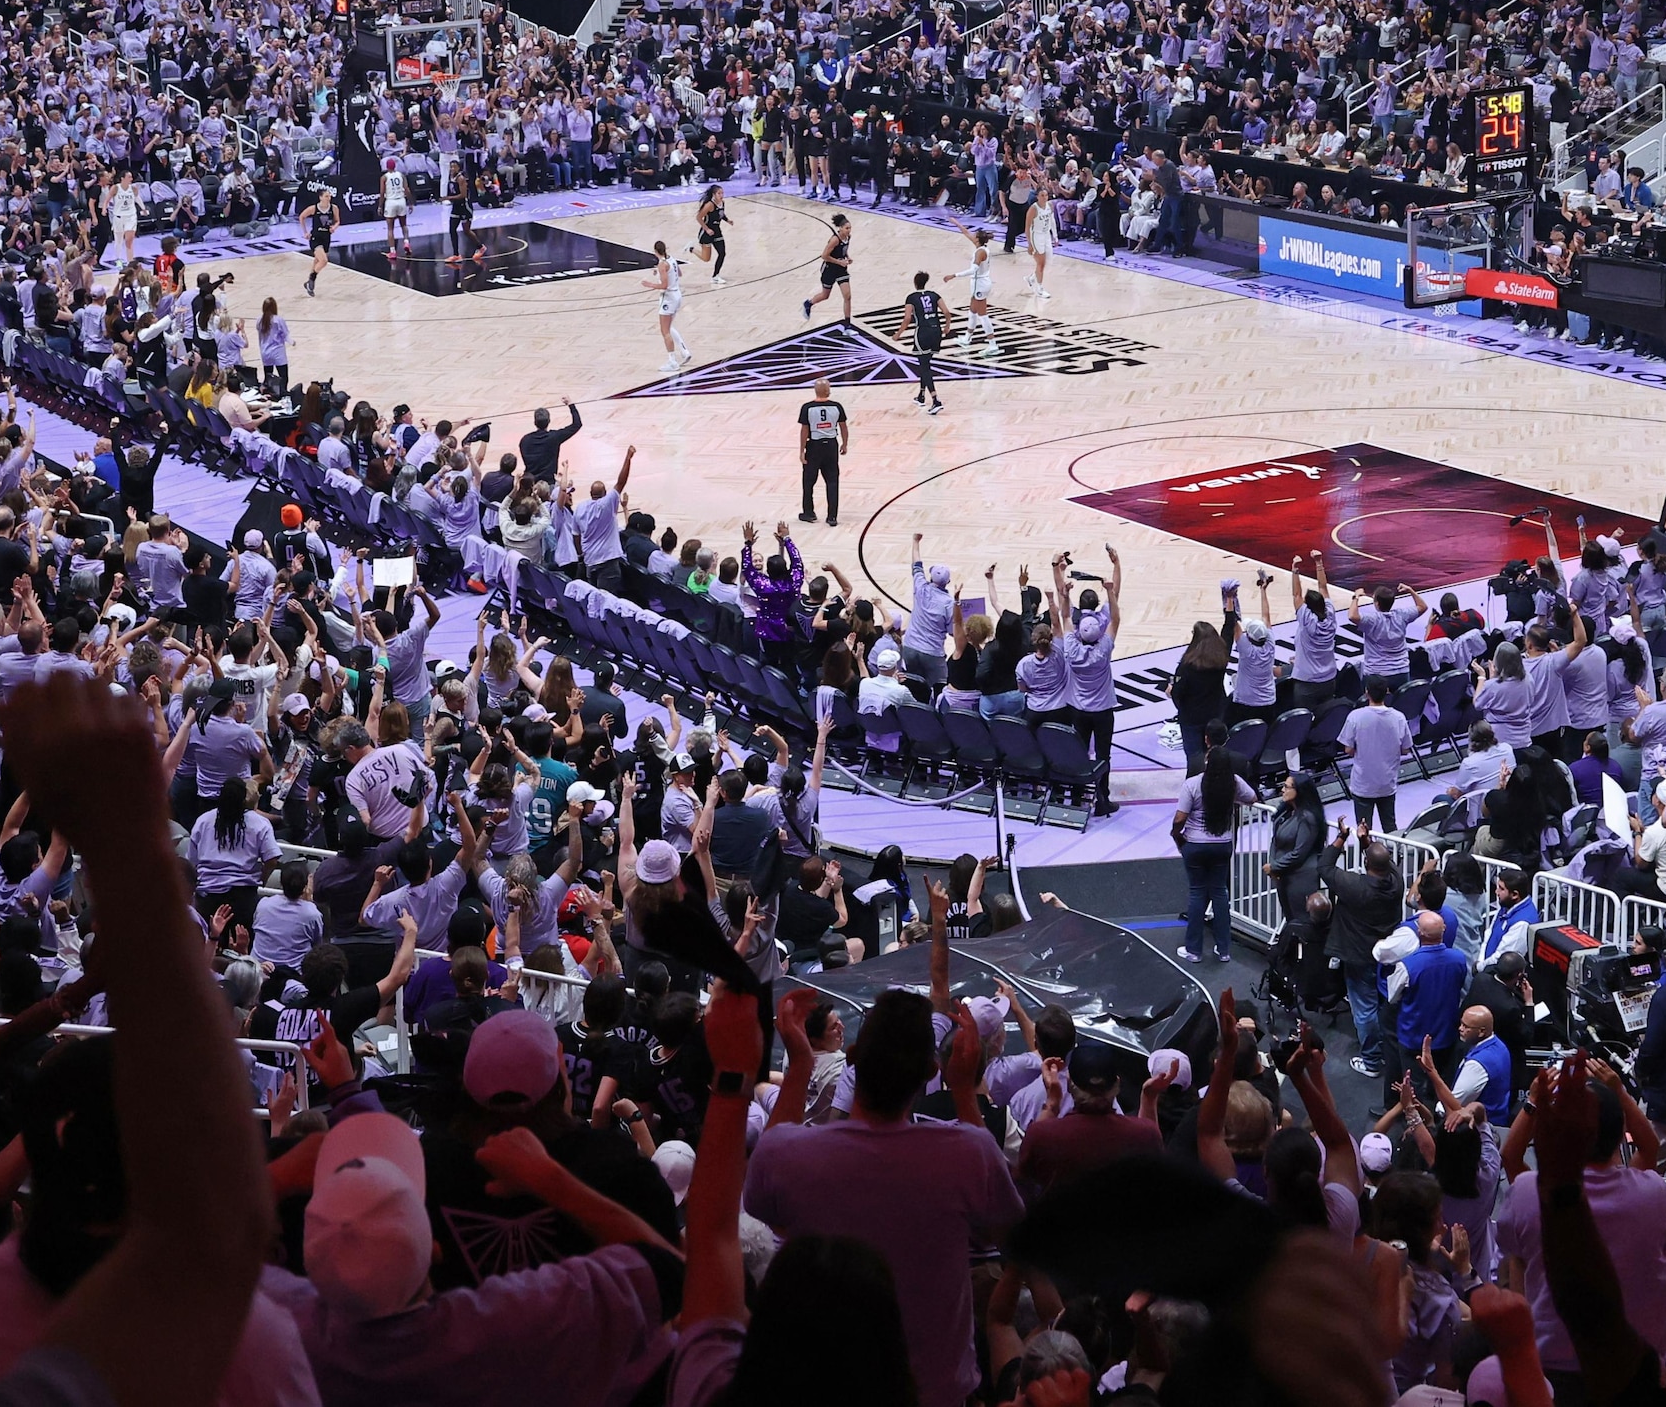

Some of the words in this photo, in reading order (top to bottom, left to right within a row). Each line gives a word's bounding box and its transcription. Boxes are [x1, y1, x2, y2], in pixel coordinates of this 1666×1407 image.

[1488, 94, 1523, 117] 5:48
[1481, 115, 1520, 154] 24
[1492, 157, 1528, 171] TISSOT
[390, 177, 401, 188] 10
[1279, 235, 1382, 280] JrWNBALeagues.com
[518, 266, 613, 283] WNBA
[1507, 281, 1555, 301] StateFarm
[920, 296, 932, 309] 12
[1054, 328, 1161, 354] STATE
[821, 409, 827, 422] 9
[1169, 467, 1293, 493] WNBA
[285, 544, 294, 561] 0
[360, 751, 400, 791] GSV
[634, 761, 646, 782] 5
[540, 777, 558, 791] TON
